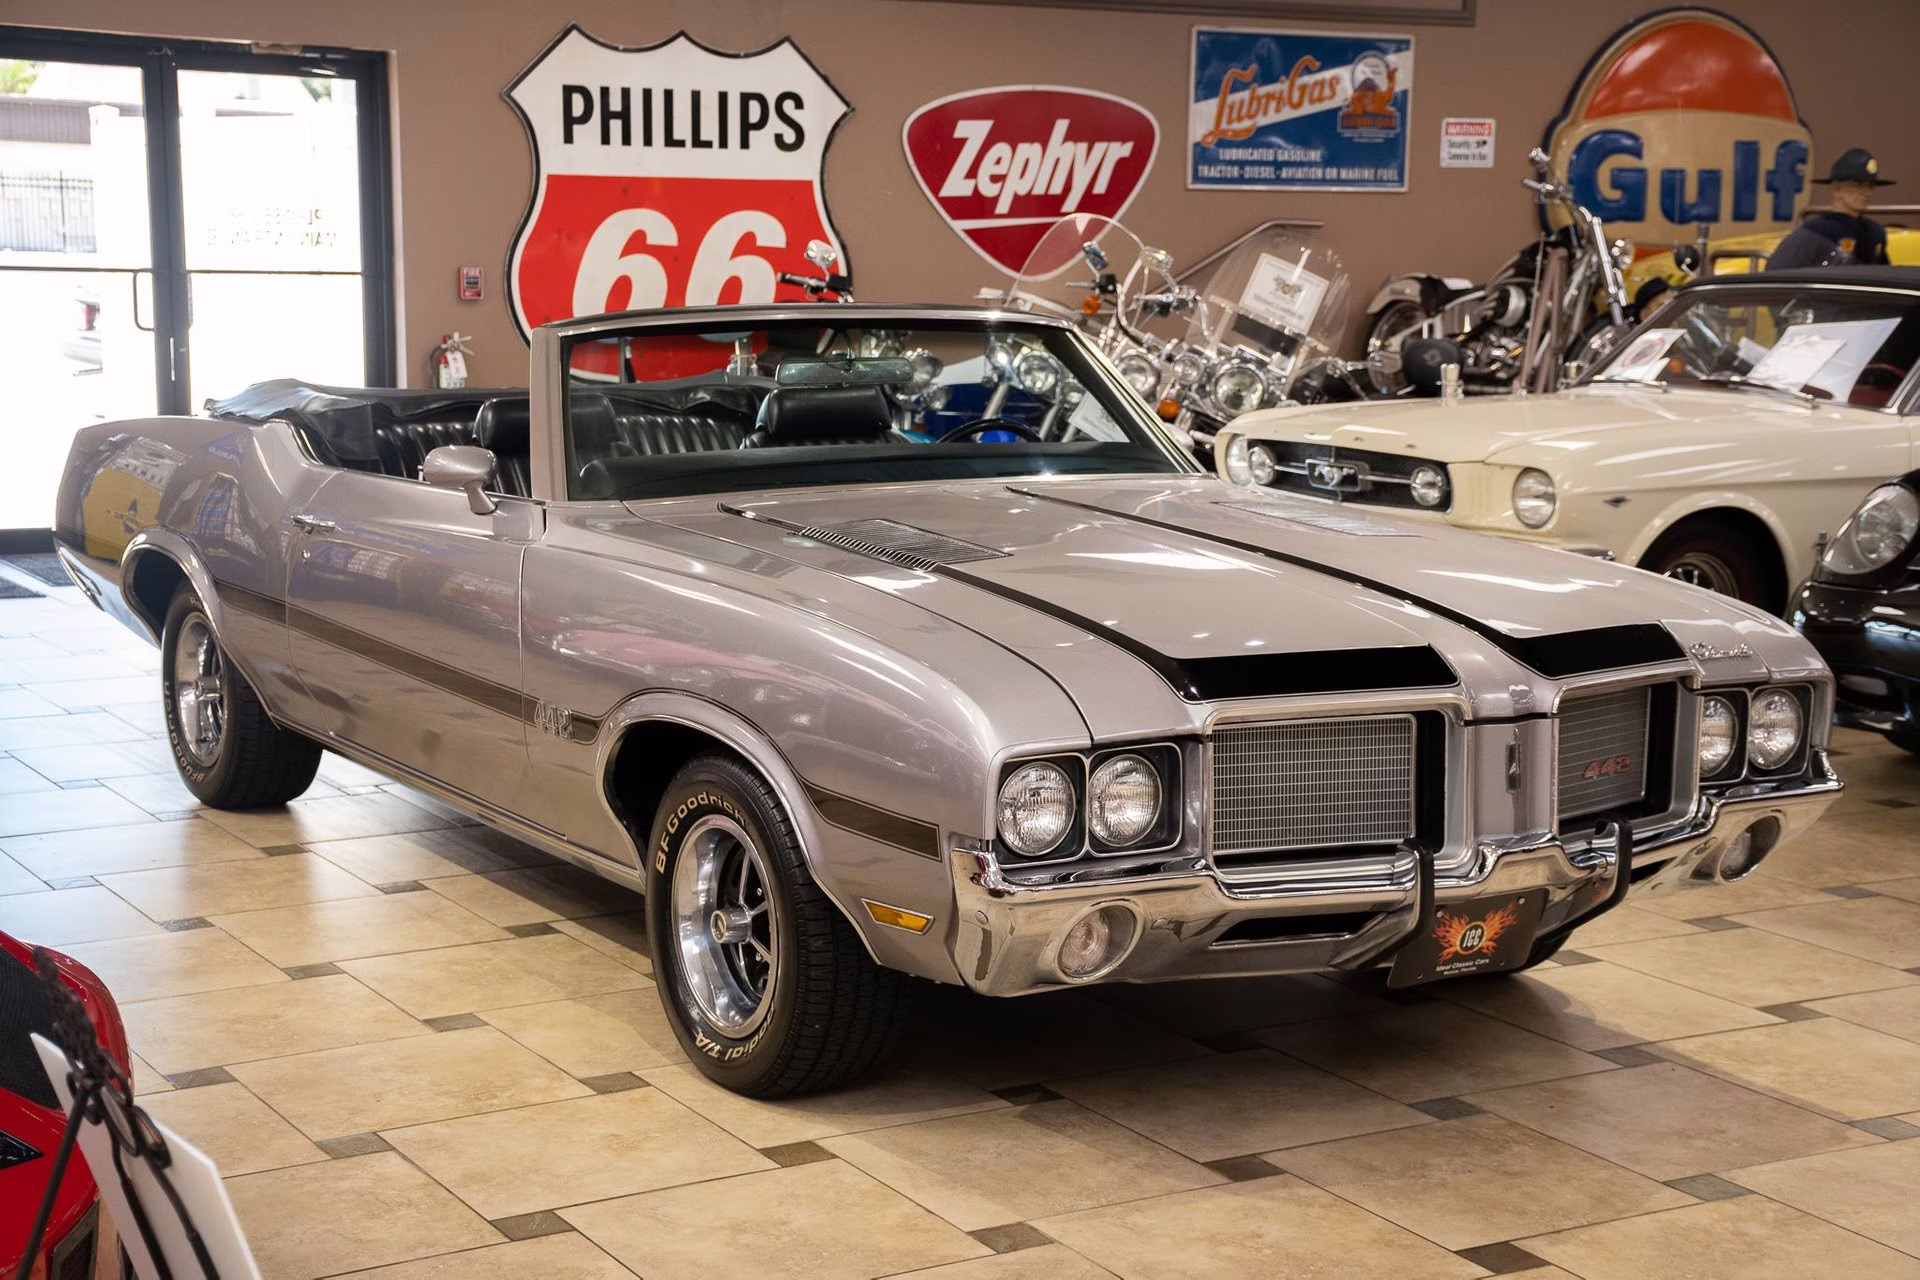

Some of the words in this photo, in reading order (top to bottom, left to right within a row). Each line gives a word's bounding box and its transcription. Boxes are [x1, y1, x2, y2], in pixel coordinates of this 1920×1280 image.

[562, 84, 805, 152] PHILLIPS
[938, 119, 1134, 214] Zephyr
[1567, 129, 1808, 225] Gulf
[572, 208, 788, 319] 66
[534, 700, 573, 740] 442
